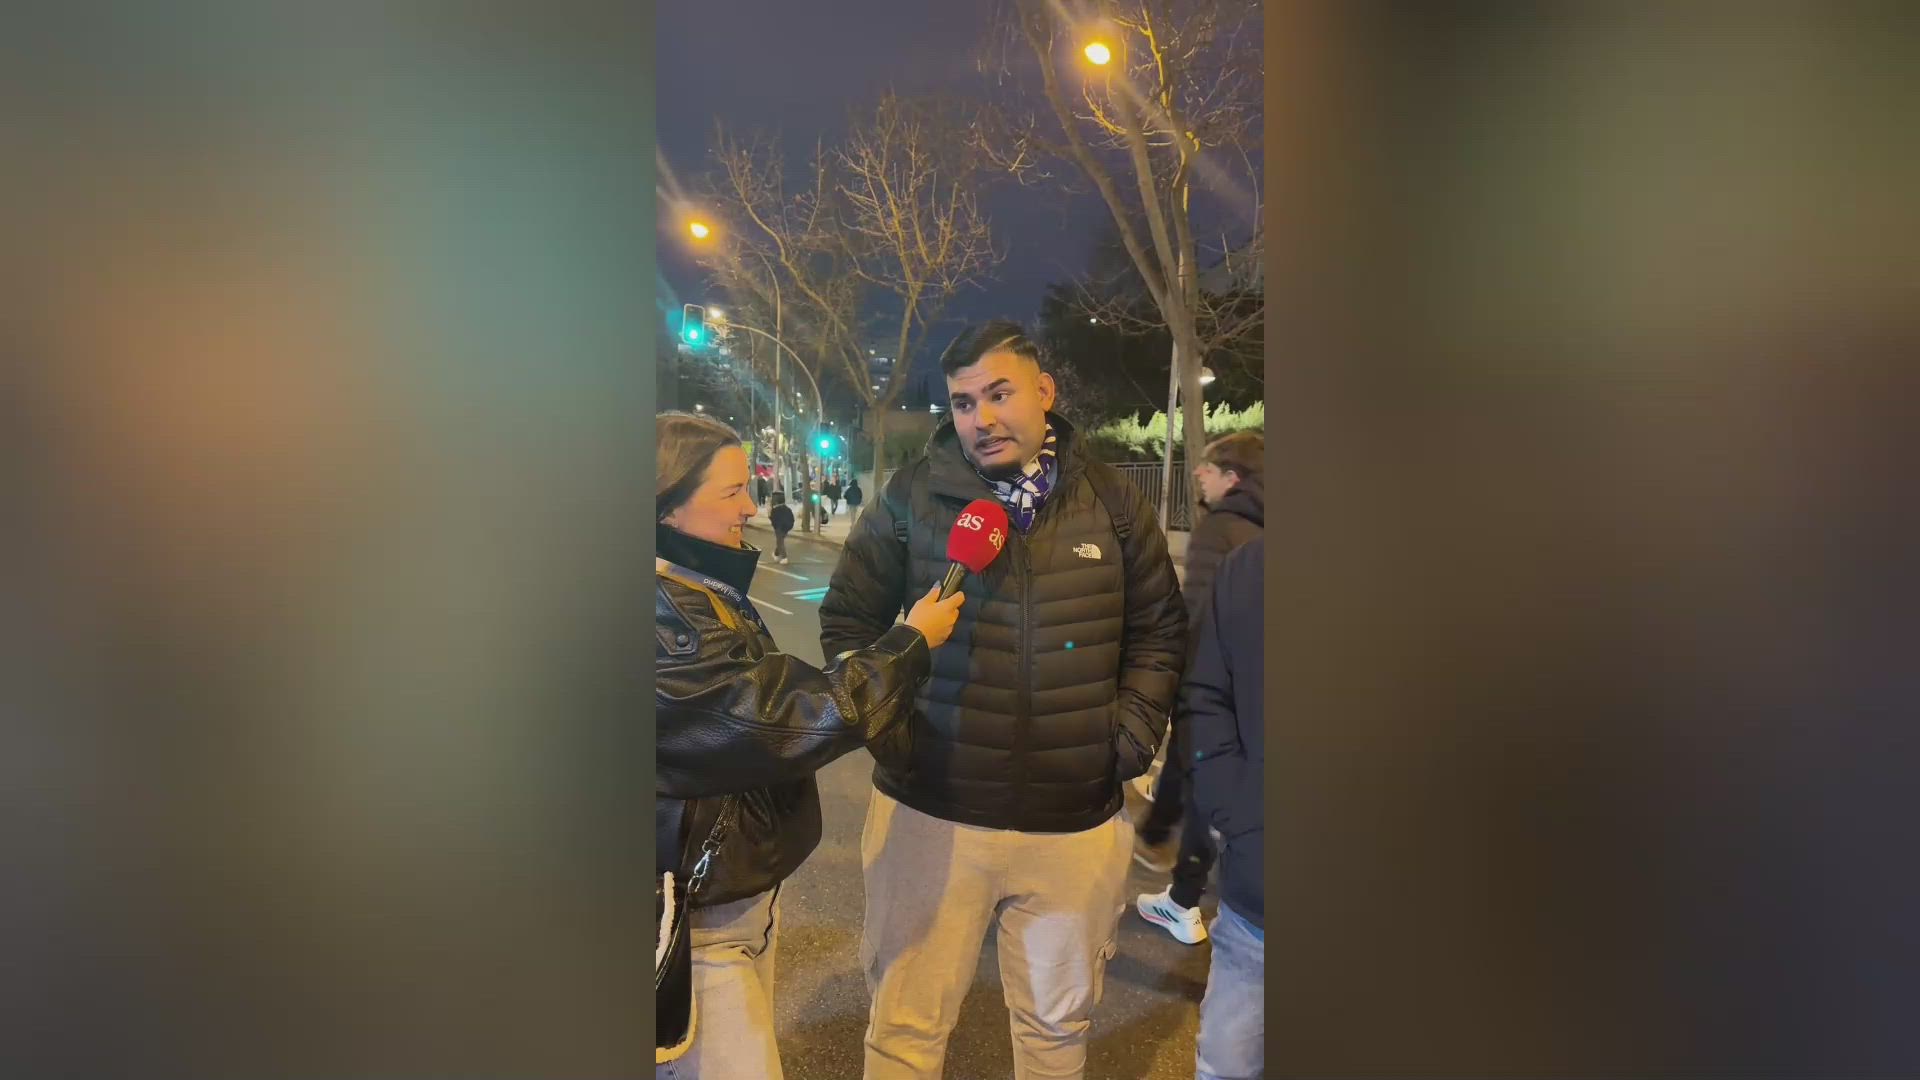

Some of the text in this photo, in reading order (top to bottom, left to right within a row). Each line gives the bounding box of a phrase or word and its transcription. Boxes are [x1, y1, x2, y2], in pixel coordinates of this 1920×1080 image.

[957, 513, 984, 531] as
[704, 578, 742, 601] Real Madrid
